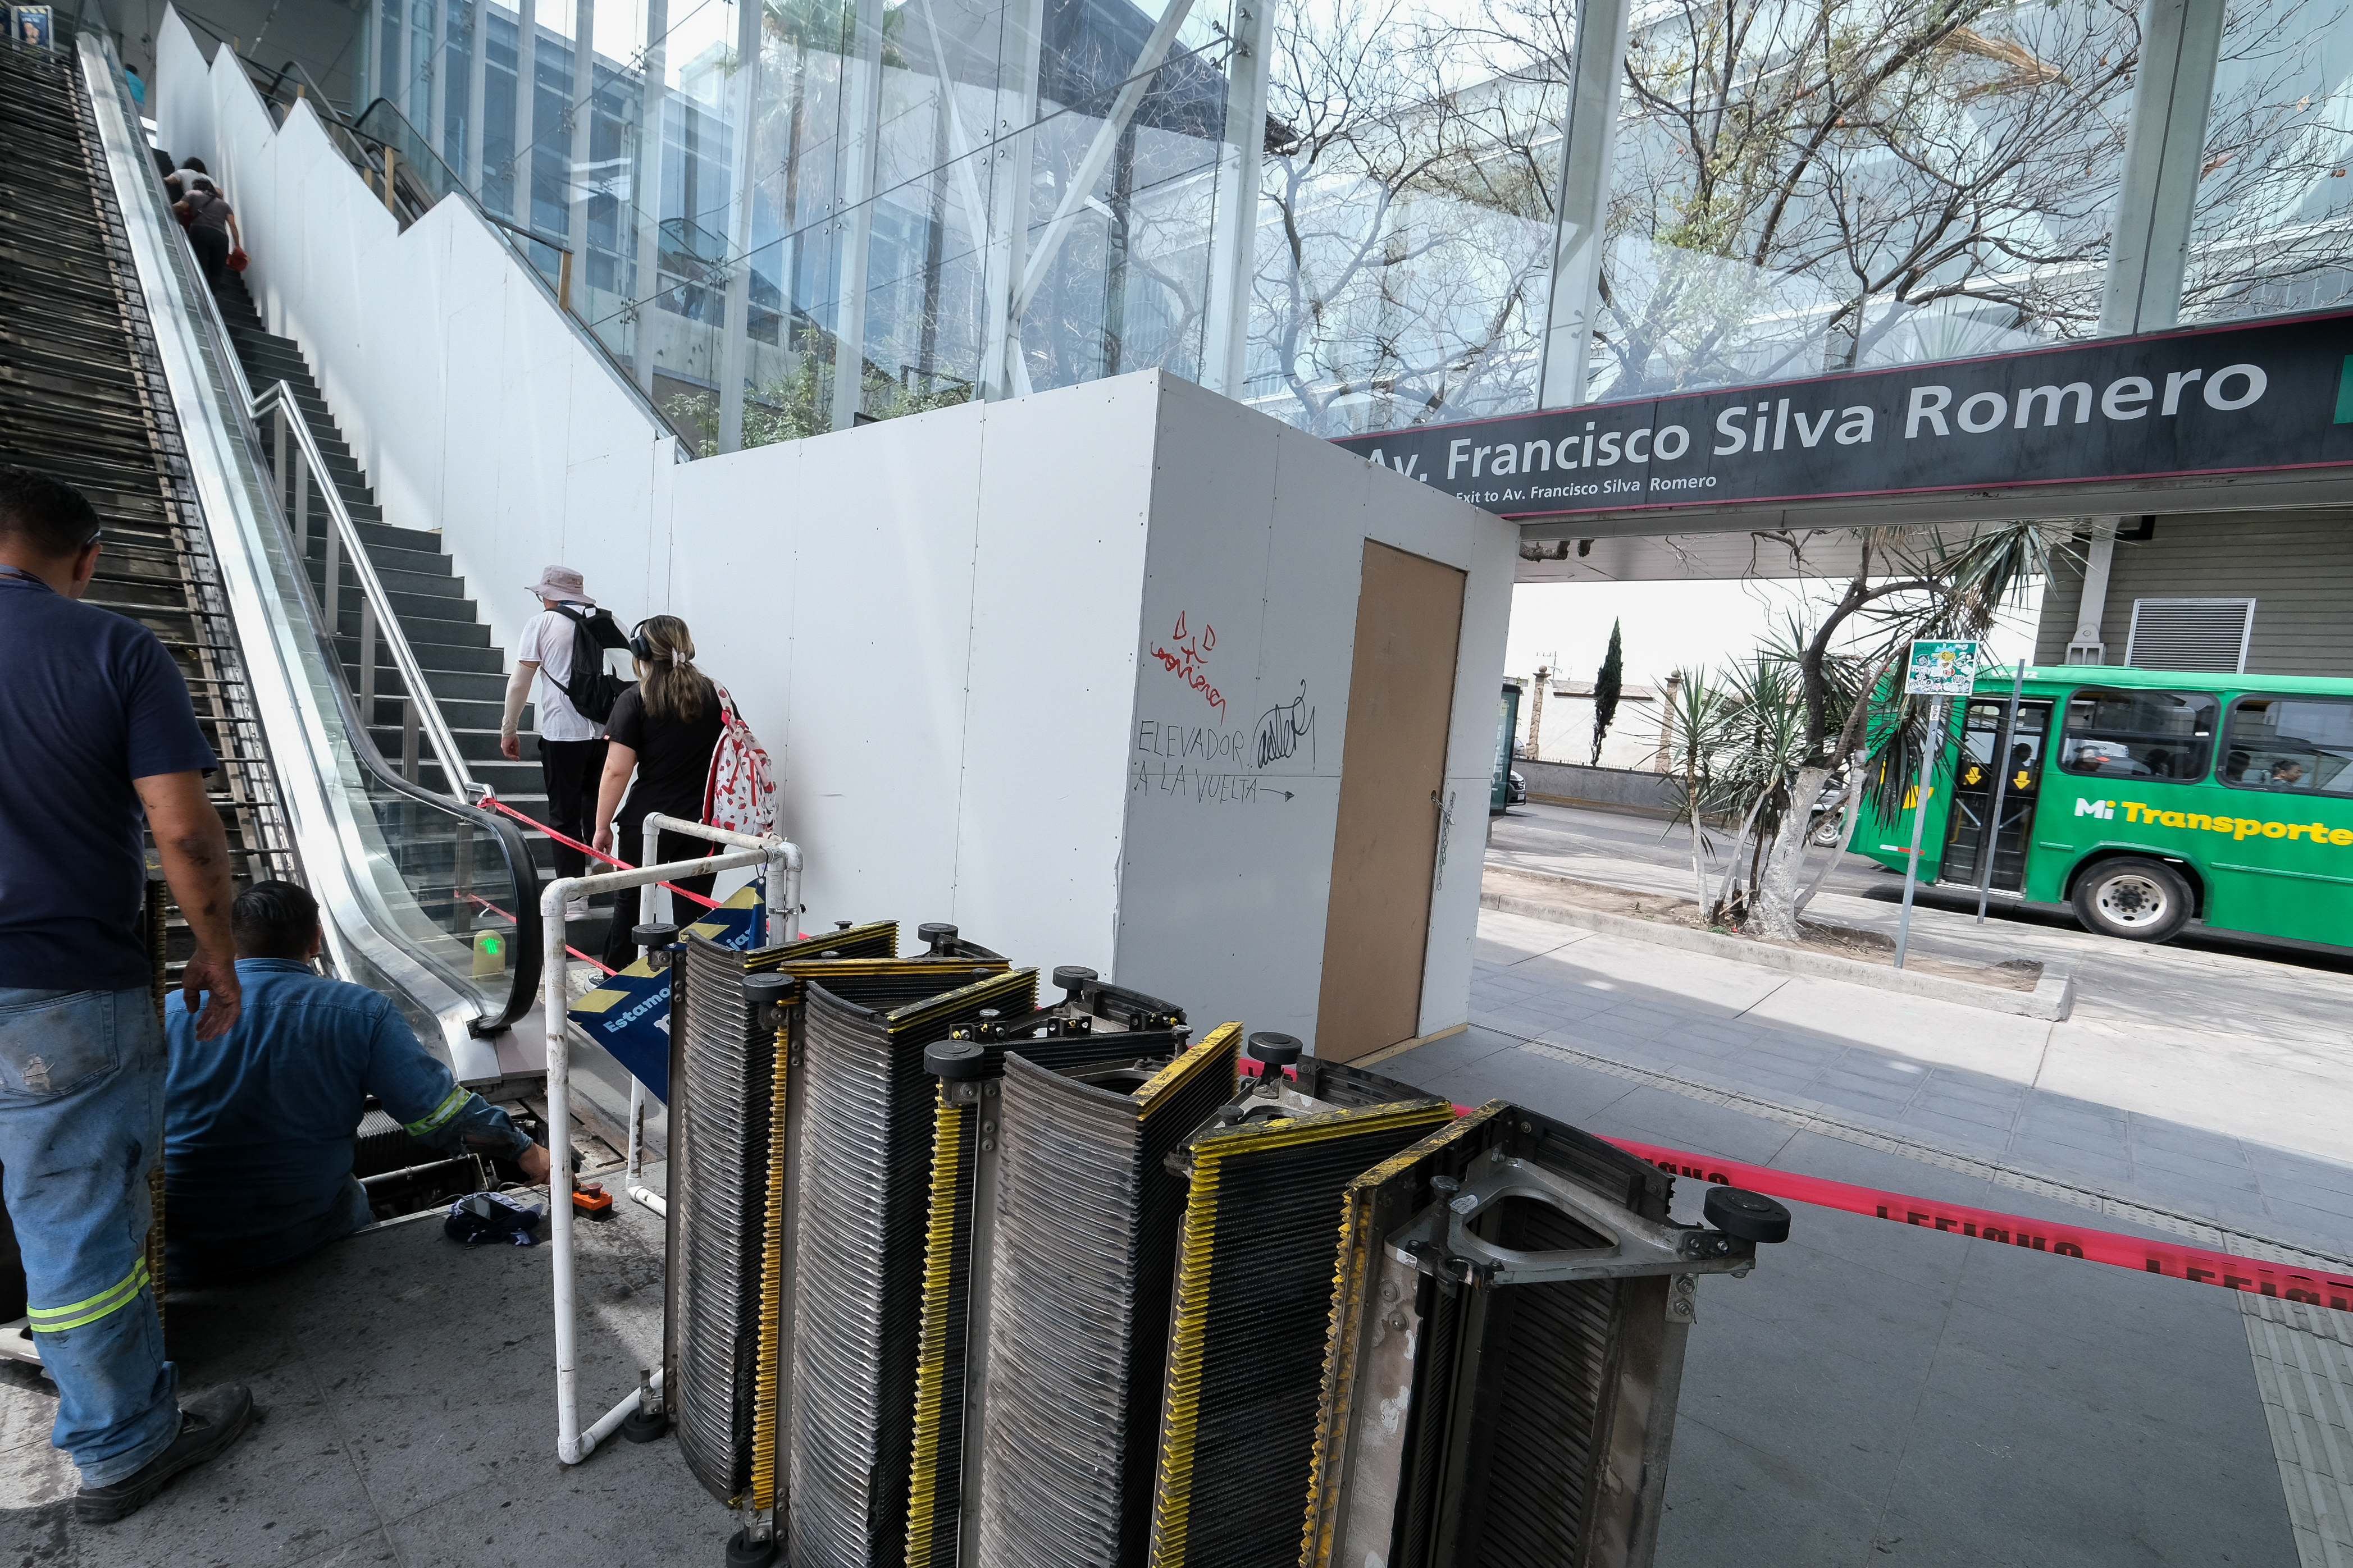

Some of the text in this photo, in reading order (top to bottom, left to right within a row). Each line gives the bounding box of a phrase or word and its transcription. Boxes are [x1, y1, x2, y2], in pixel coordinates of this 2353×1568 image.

[1447, 420, 1690, 481] Francisco
[1713, 398, 1875, 456] Silva
[1904, 363, 2268, 440] Romero
[1484, 490, 1499, 502] to
[1502, 488, 1526, 501] Av.
[1530, 482, 1599, 499] Francisco
[1603, 478, 1641, 493] Silva
[1650, 476, 1717, 491] Romero
[1139, 720, 1245, 770] ELEVADOR
[1136, 760, 1257, 804] A LA VUELTA
[2074, 792, 2353, 846] Mi Transporte
[603, 983, 671, 1033] Estamo
